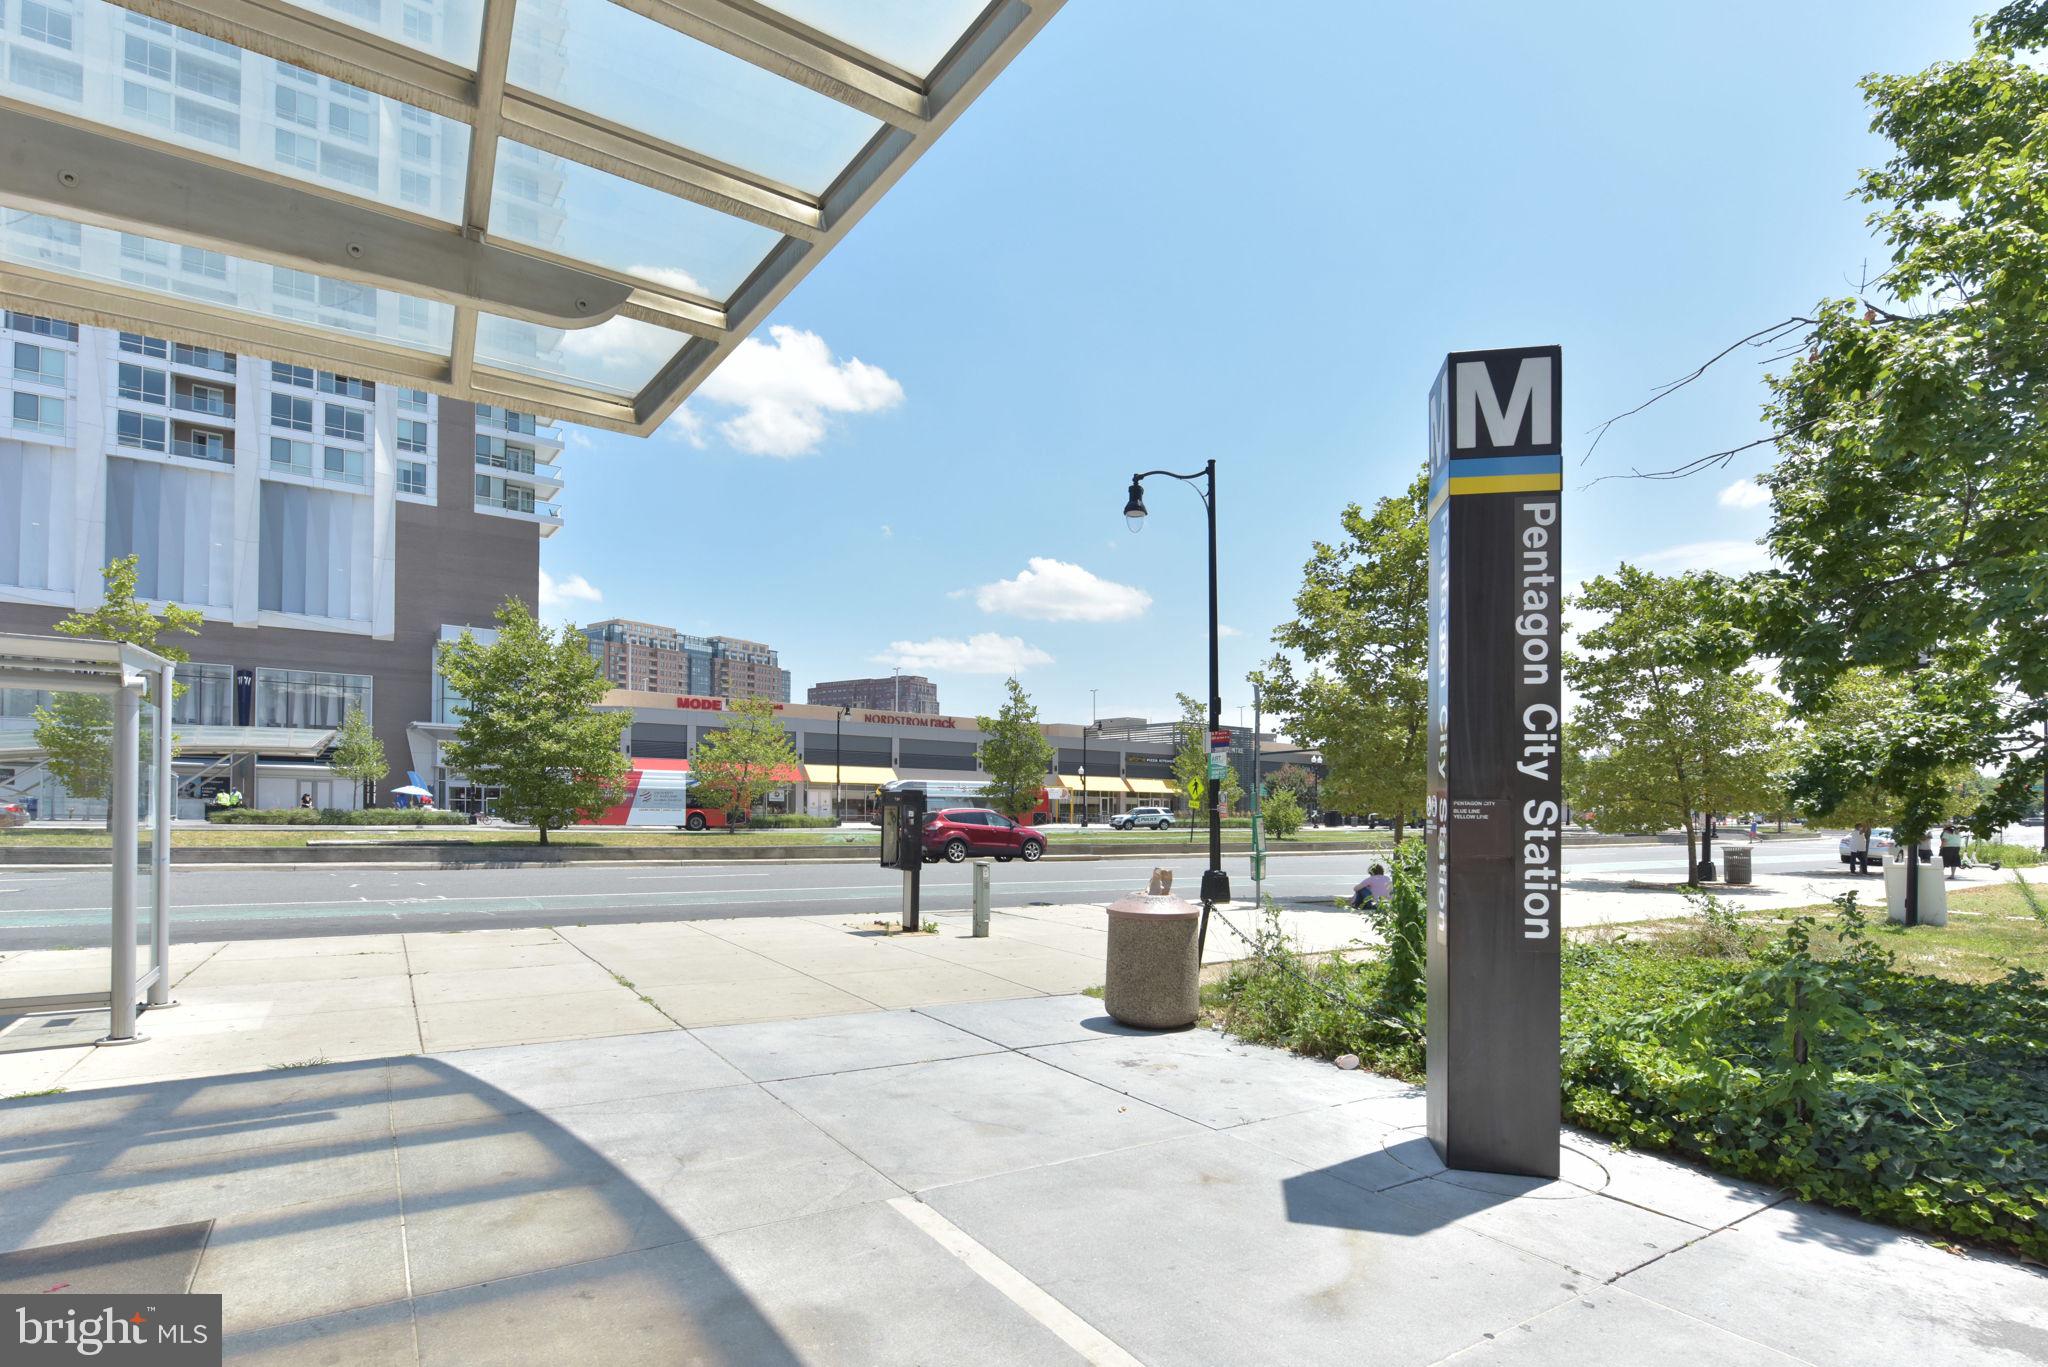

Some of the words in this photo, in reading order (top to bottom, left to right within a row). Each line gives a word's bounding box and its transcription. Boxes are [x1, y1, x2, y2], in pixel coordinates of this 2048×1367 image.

[1456, 356, 1552, 449] M
[1515, 502, 1556, 685] Pentagon
[864, 713, 928, 727] NORDSTROM
[929, 717, 956, 729] rack
[1516, 703, 1559, 781] City
[1523, 799, 1559, 939] Station
